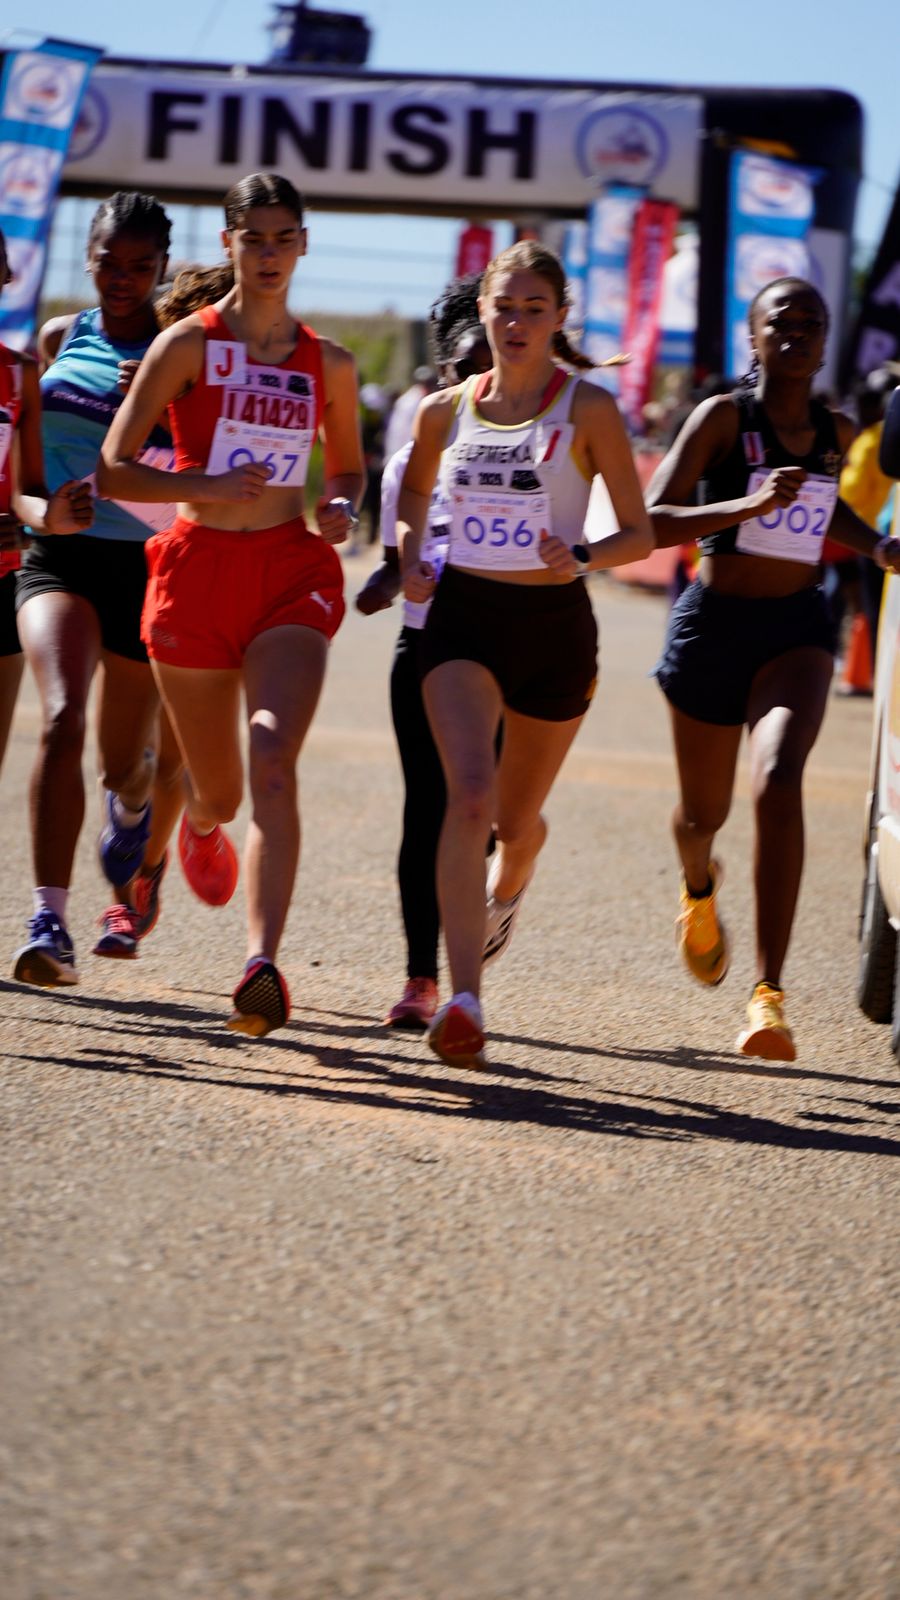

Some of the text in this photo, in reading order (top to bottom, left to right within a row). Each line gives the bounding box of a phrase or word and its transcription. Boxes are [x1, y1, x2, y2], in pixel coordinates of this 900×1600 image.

[146, 90, 537, 180] FINISH
[215, 347, 233, 378] J
[464, 516, 534, 548] 056
[758, 504, 826, 537] 002
